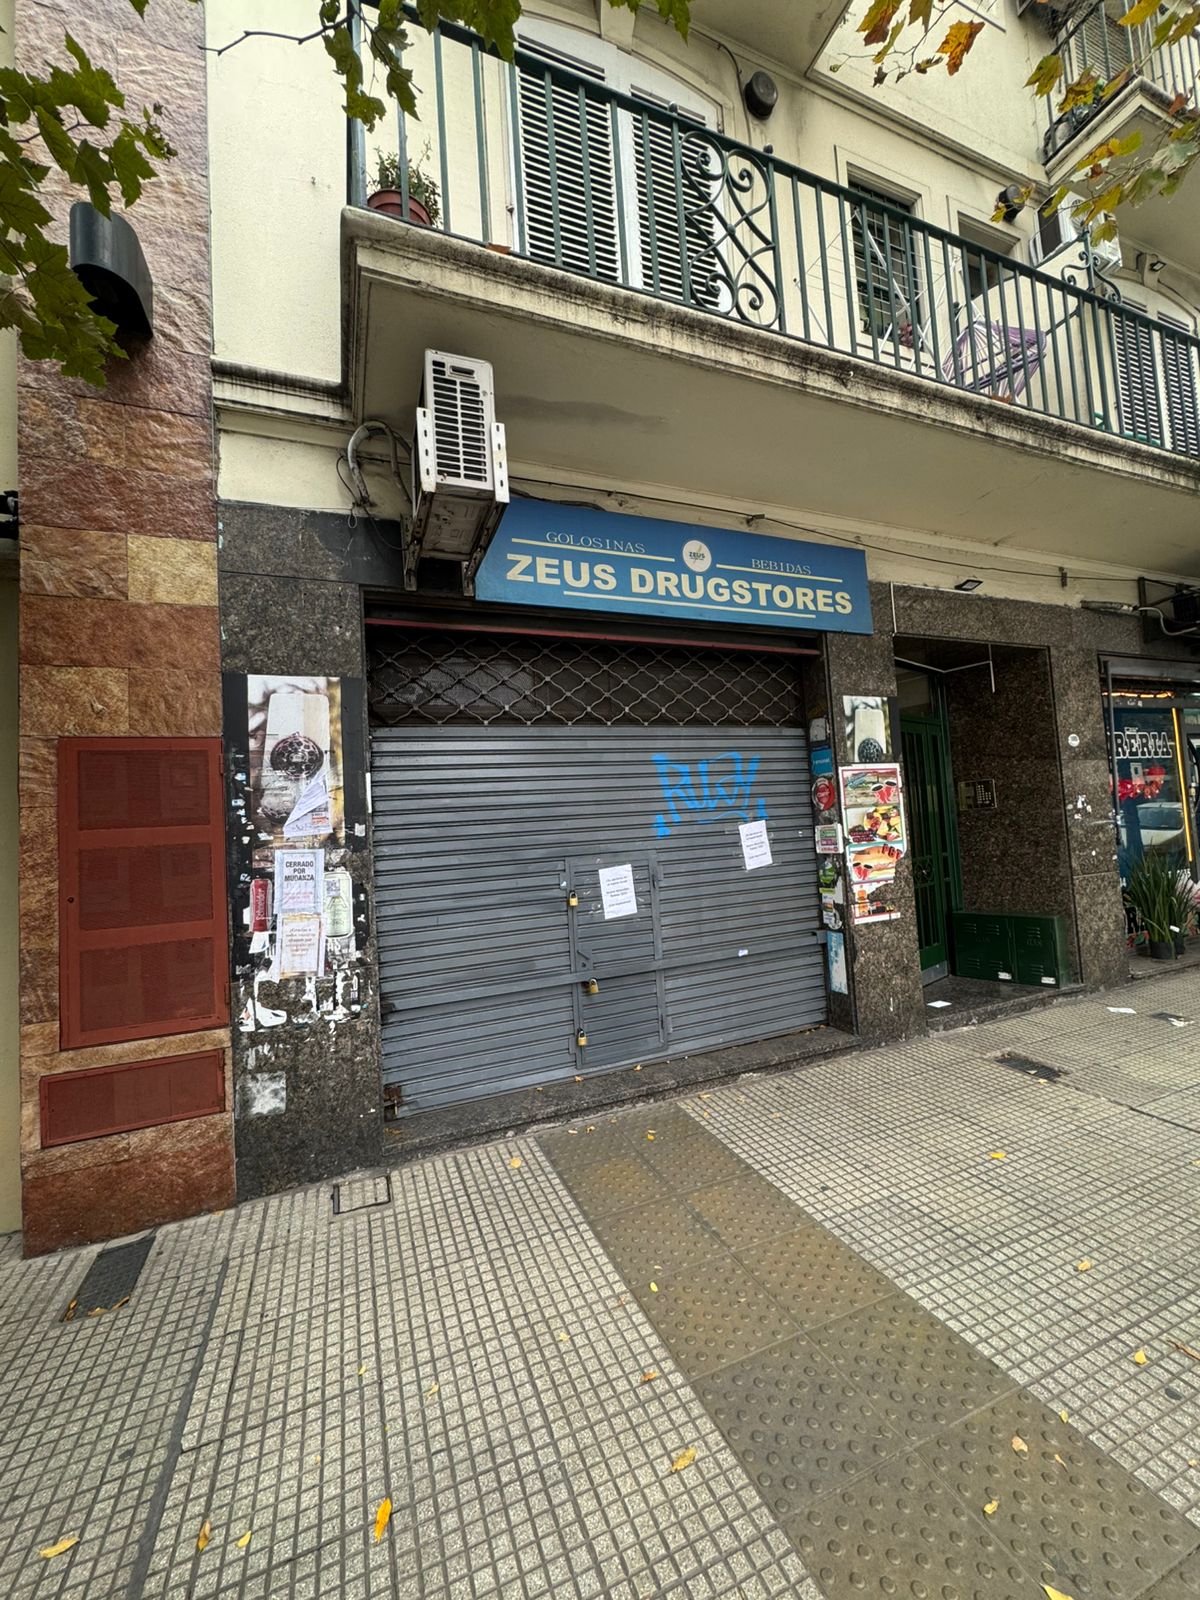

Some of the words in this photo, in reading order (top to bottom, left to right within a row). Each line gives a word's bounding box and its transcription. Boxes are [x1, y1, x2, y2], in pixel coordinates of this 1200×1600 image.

[545, 531, 646, 554] GOLOSINAS
[688, 551, 706, 559] ZEUS
[751, 558, 812, 576] BEBIDAS
[506, 553, 617, 590] ZEUS
[630, 567, 853, 615] DRUGSTORES
[284, 874, 315, 882] MUDANZA
